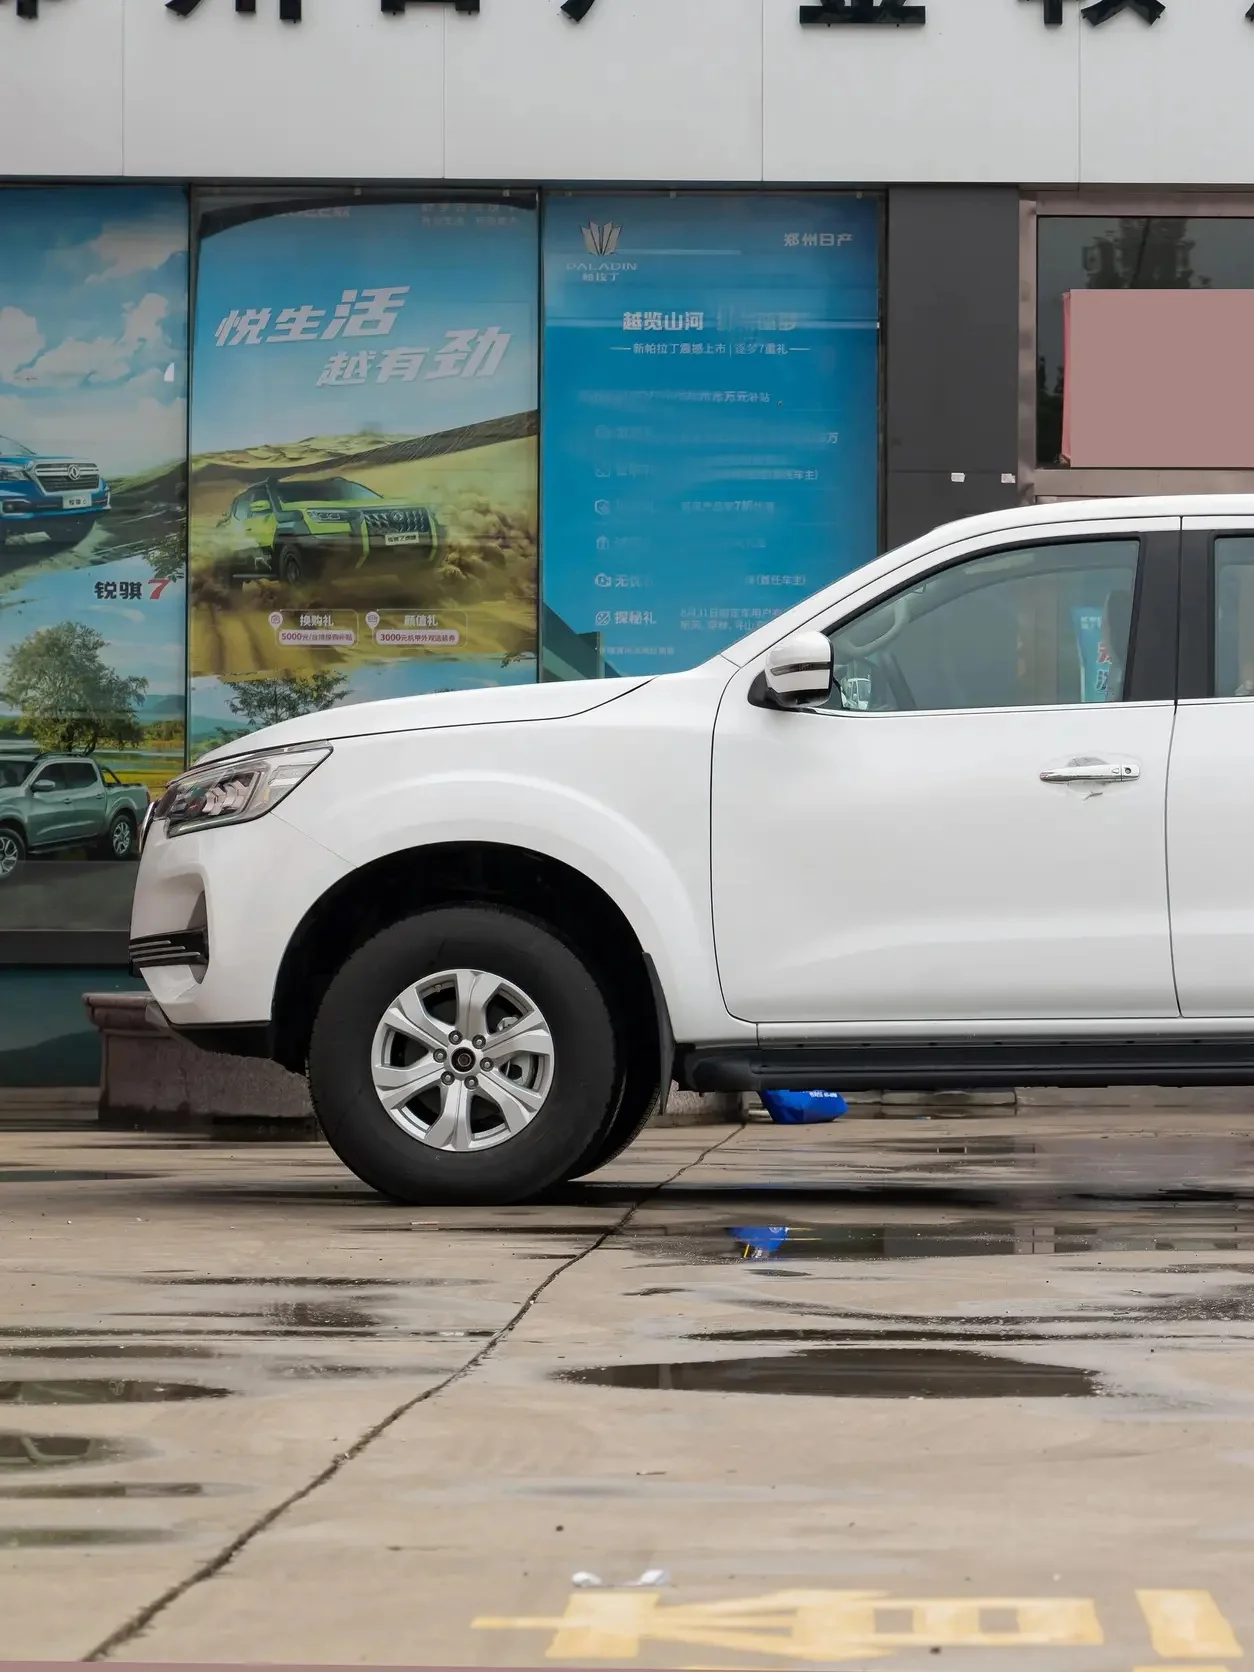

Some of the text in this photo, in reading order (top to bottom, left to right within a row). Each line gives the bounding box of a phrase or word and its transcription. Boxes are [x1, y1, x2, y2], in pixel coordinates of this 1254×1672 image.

[783, 232, 854, 247] 郑州日产
[566, 263, 638, 271] PALADIN
[582, 272, 620, 282] 帕拉丁
[214, 286, 411, 347] 悦生活
[623, 312, 704, 331] 越览山河
[315, 327, 513, 387] 越有劲
[94, 578, 170, 600] 锐骐7
[300, 615, 335, 627] 换购礼
[614, 611, 657, 625] 探秘礼
